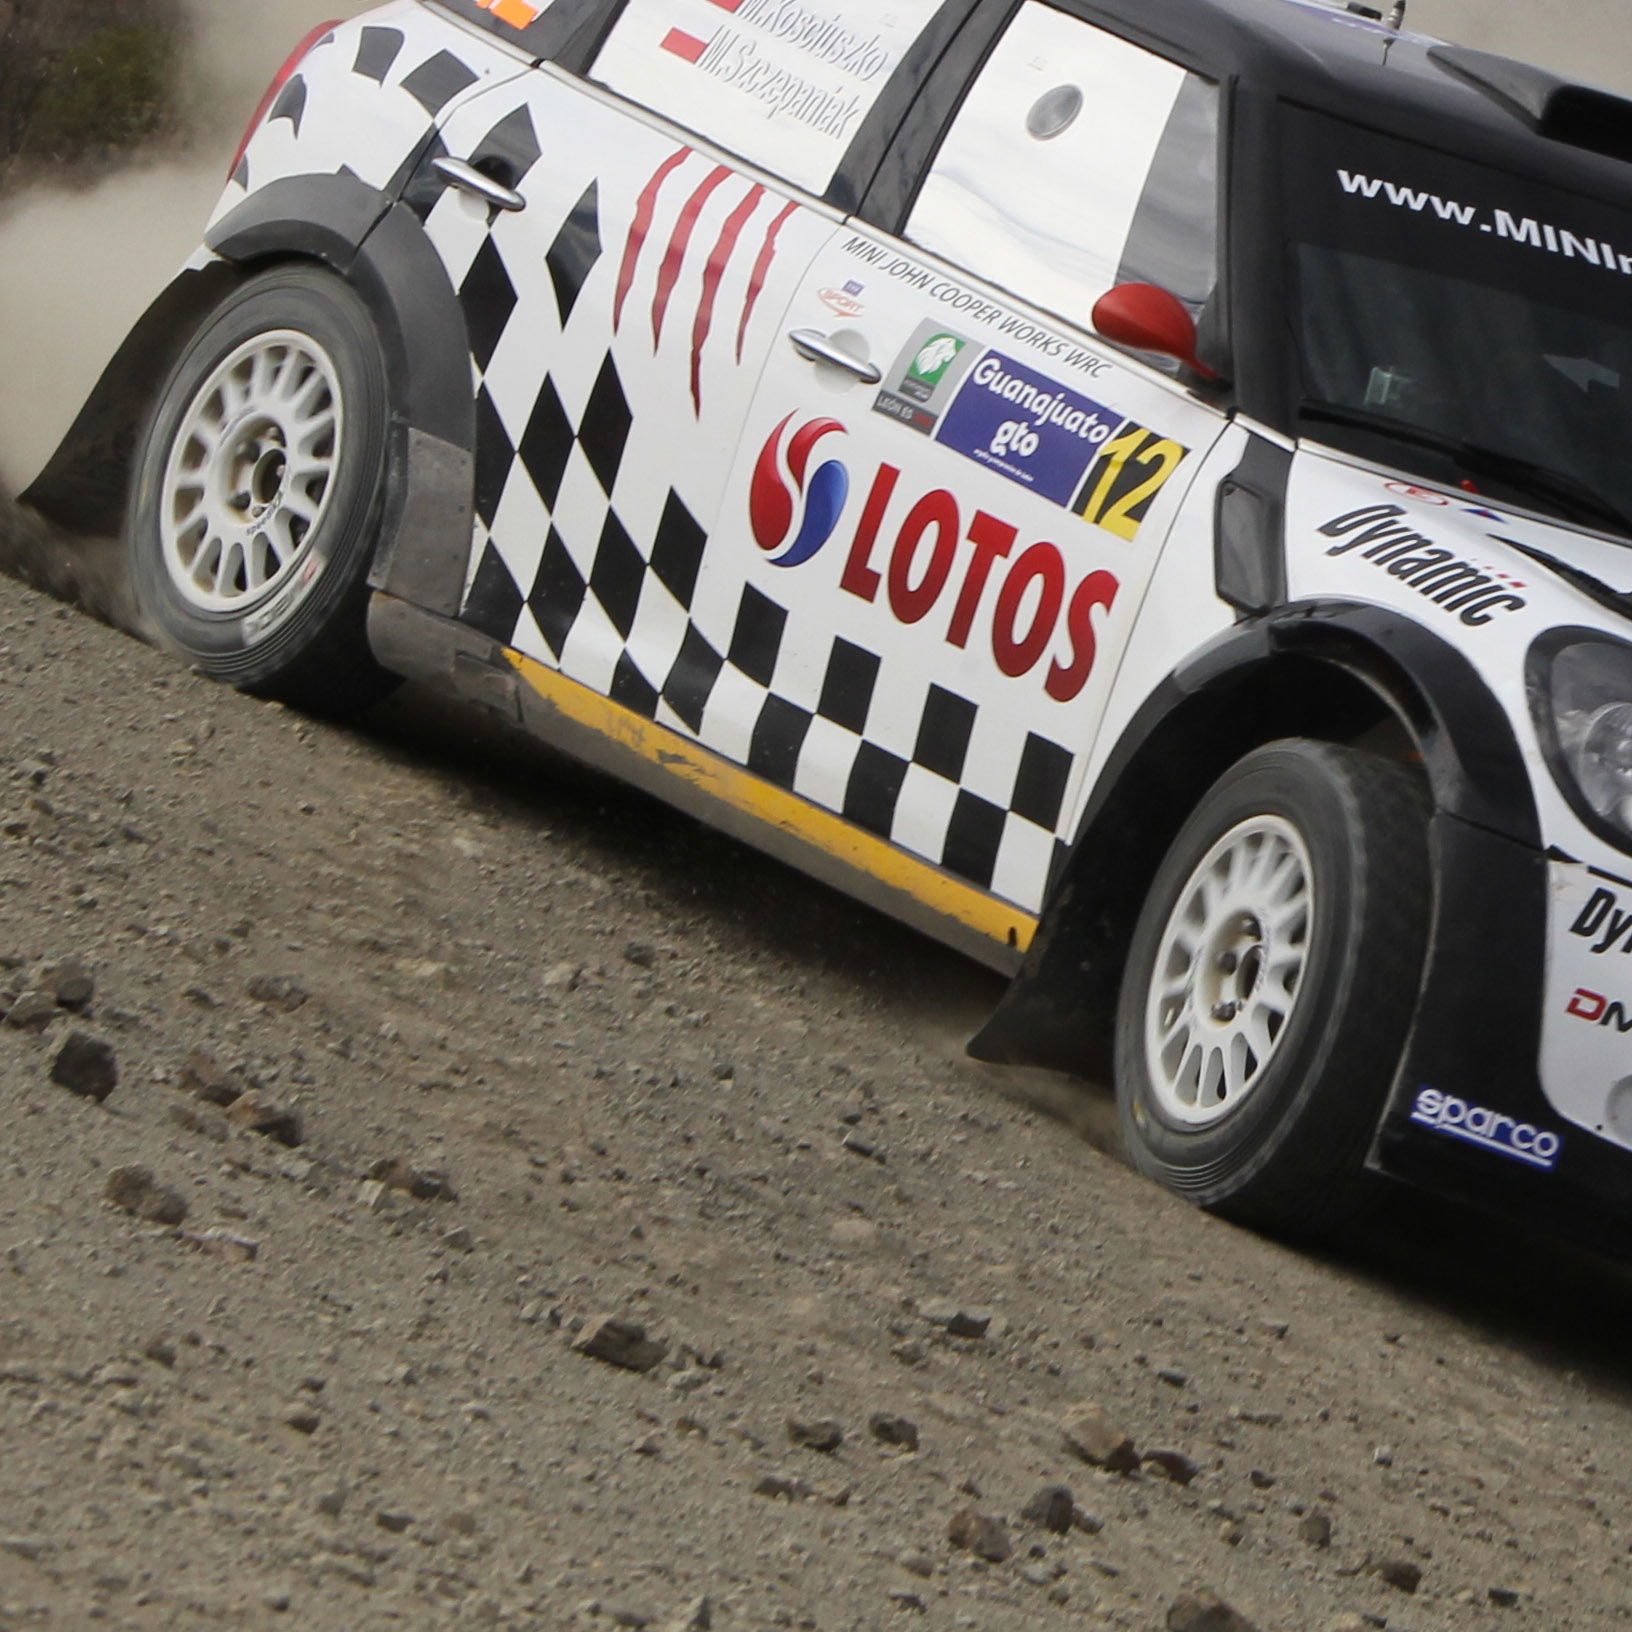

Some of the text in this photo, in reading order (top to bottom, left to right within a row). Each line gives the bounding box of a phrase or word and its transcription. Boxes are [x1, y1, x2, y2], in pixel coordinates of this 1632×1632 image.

[699, 24, 860, 140] M.Szczepaniak
[841, 236, 888, 266] MINI
[878, 258, 934, 291] JOHN
[929, 282, 1003, 325] COOPER
[998, 314, 1065, 357] WORKS
[1065, 346, 1113, 379] WRC
[972, 357, 1184, 543] Guanajuato 12
[989, 420, 1040, 457] gto
[839, 461, 1121, 703] LOTOS
[1315, 504, 1527, 627] Dynamic
[1414, 1087, 1560, 1160] sparco
